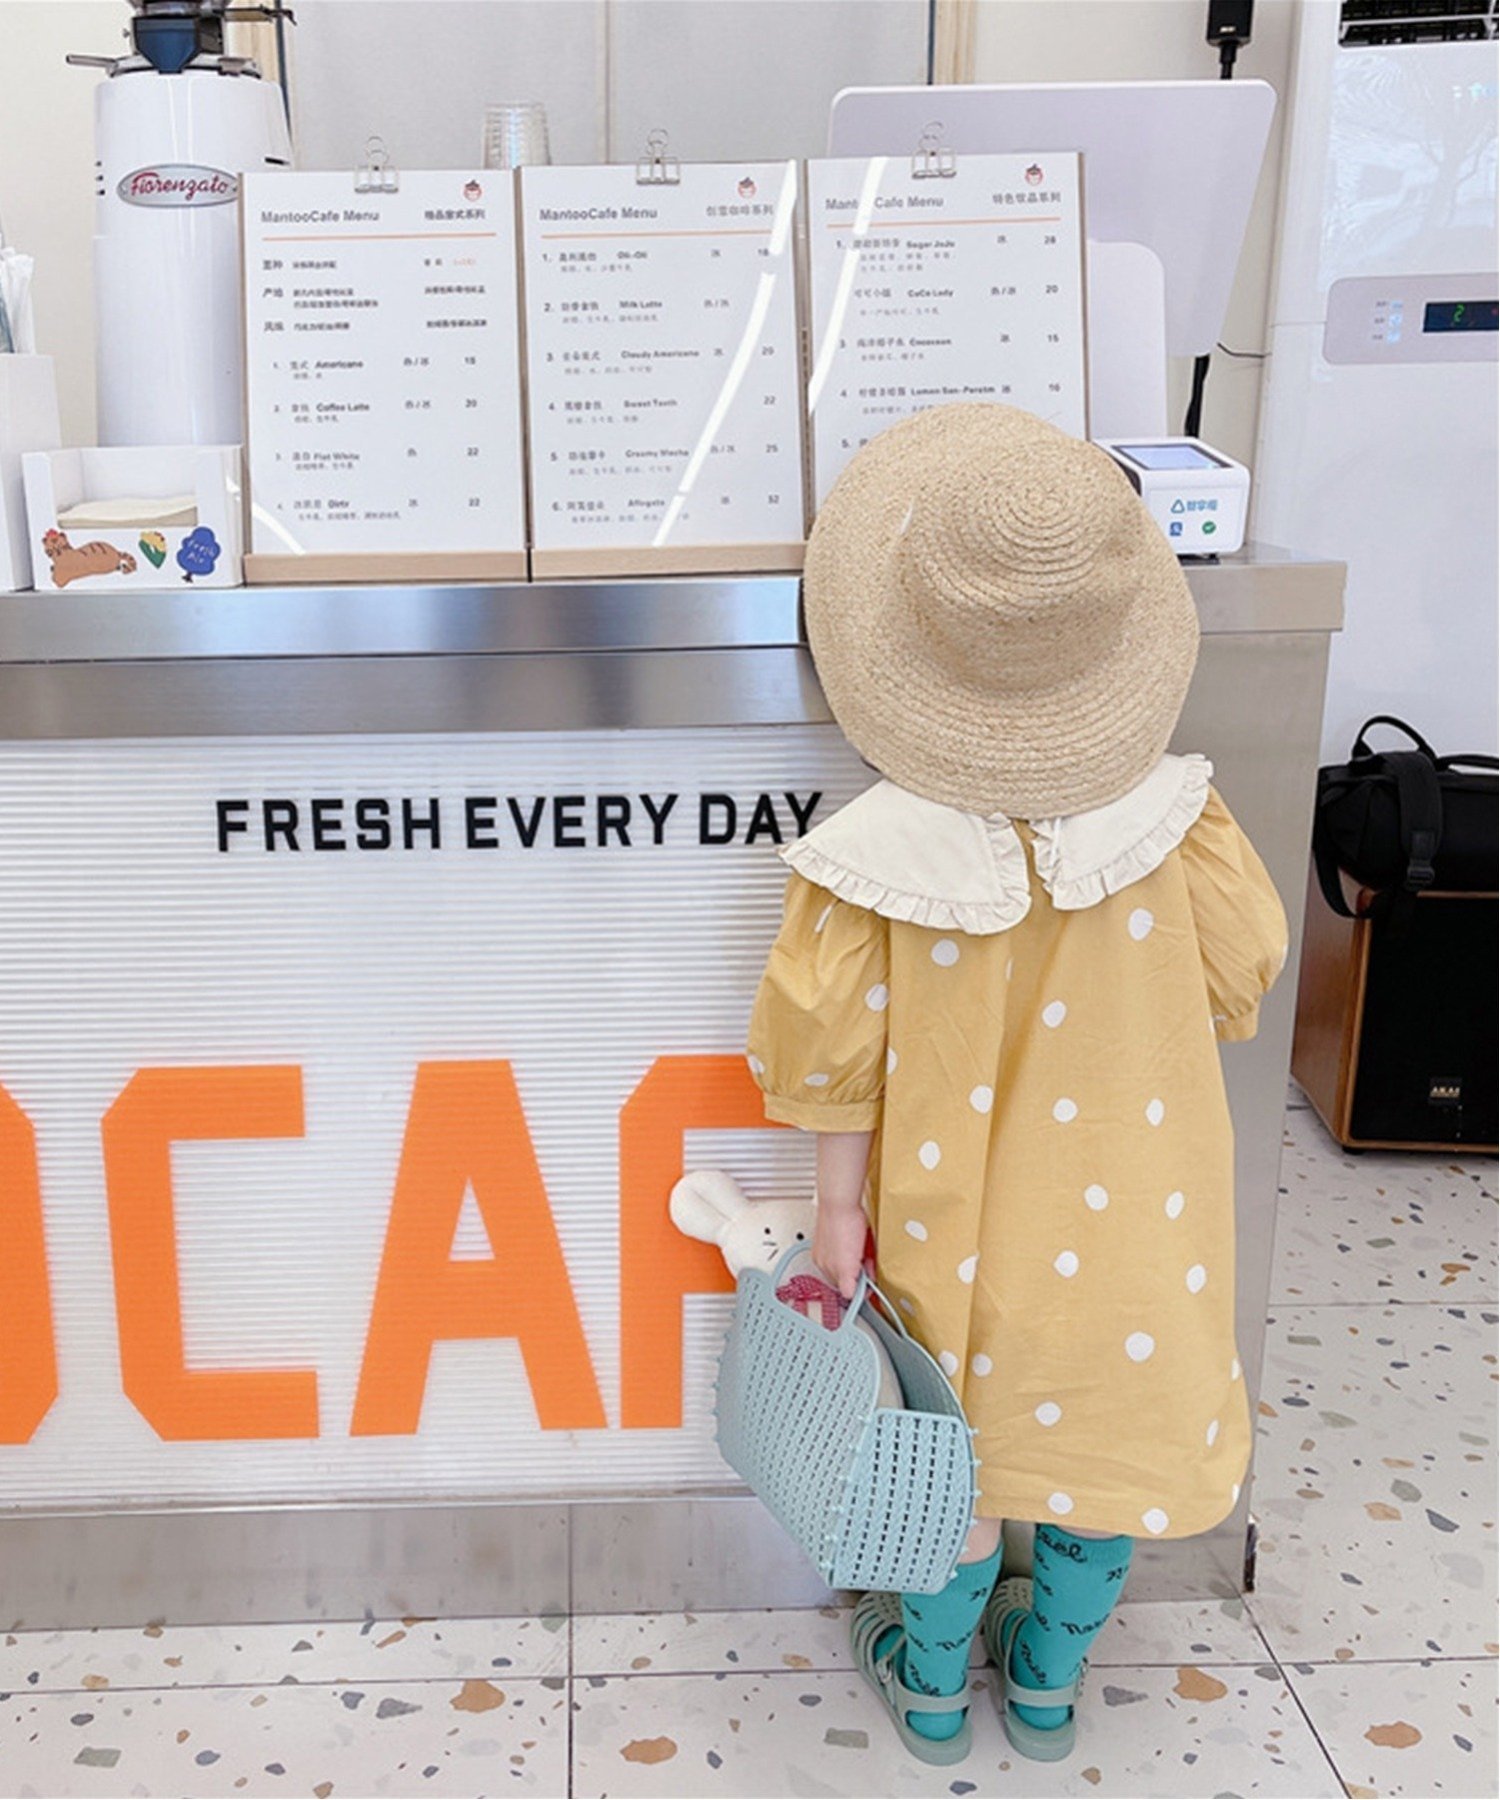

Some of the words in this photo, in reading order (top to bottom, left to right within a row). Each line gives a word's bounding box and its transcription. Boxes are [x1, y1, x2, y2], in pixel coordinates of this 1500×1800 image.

[131, 172, 229, 201] Fiorenzato
[907, 195, 944, 208] Menu
[261, 209, 340, 224] MantooCafe
[343, 210, 380, 222] Menu
[540, 208, 618, 222] MantooCafe
[621, 207, 658, 220] Menu
[467, 447, 479, 457] 22
[468, 498, 480, 508] 22
[216, 798, 442, 852] FRESH
[464, 793, 678, 851] EVERY
[699, 791, 823, 846] DAY
[0, 1054, 806, 1445] CAF
